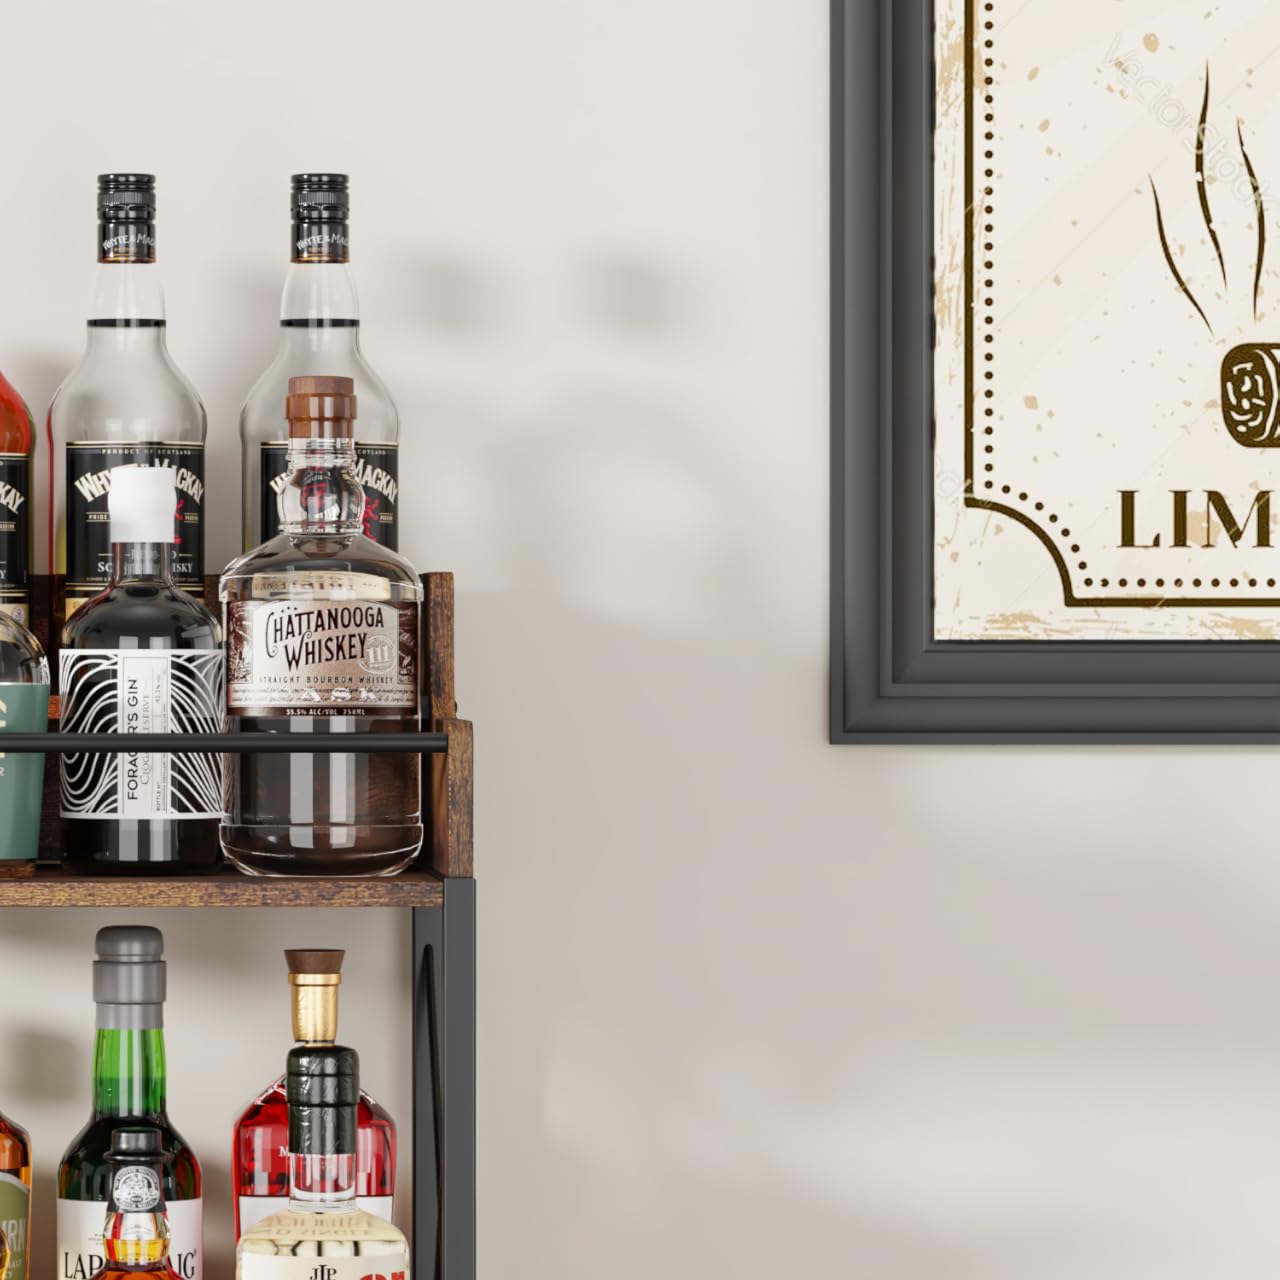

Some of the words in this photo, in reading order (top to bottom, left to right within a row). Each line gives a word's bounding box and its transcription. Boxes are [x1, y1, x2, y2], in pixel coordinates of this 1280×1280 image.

[284, 631, 369, 673] WHISKEY
[127, 679, 139, 707] GIN
[259, 676, 301, 684] STRAIGHT
[306, 676, 354, 684] BOURBON
[359, 676, 394, 684] WHISKEY
